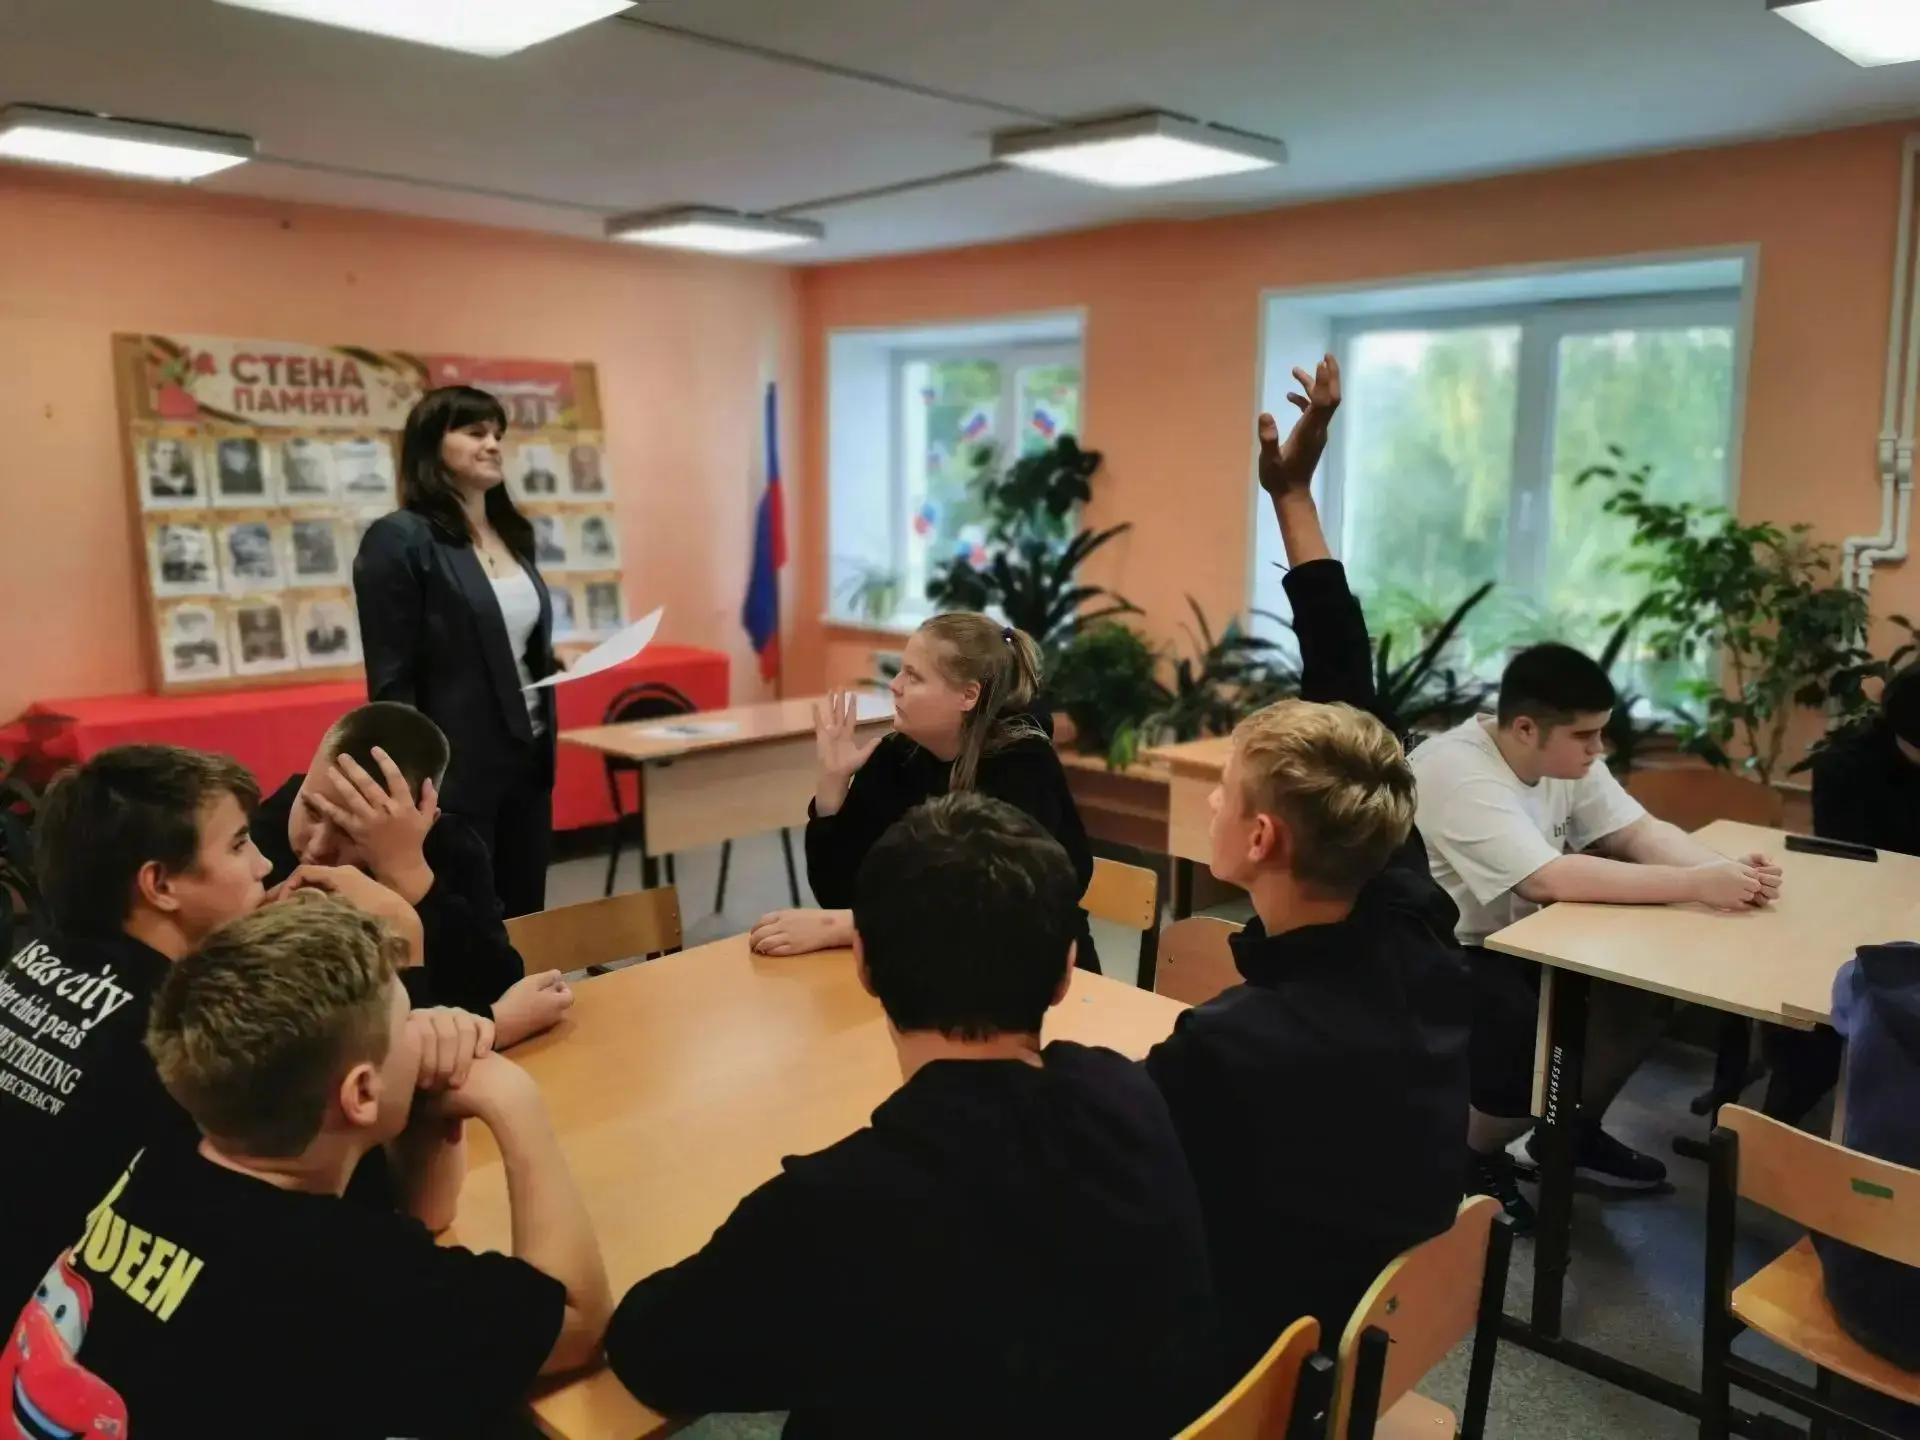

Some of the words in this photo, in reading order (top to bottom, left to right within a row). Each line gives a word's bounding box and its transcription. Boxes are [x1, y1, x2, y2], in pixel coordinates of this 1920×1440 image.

[229, 352, 365, 390] СТЕНА
[232, 386, 369, 418] ПАМЯТИ
[9, 993, 52, 1029] chick
[32, 1013, 87, 1050] peas
[55, 963, 134, 1031] city
[70, 1203, 205, 1323] UEEN
